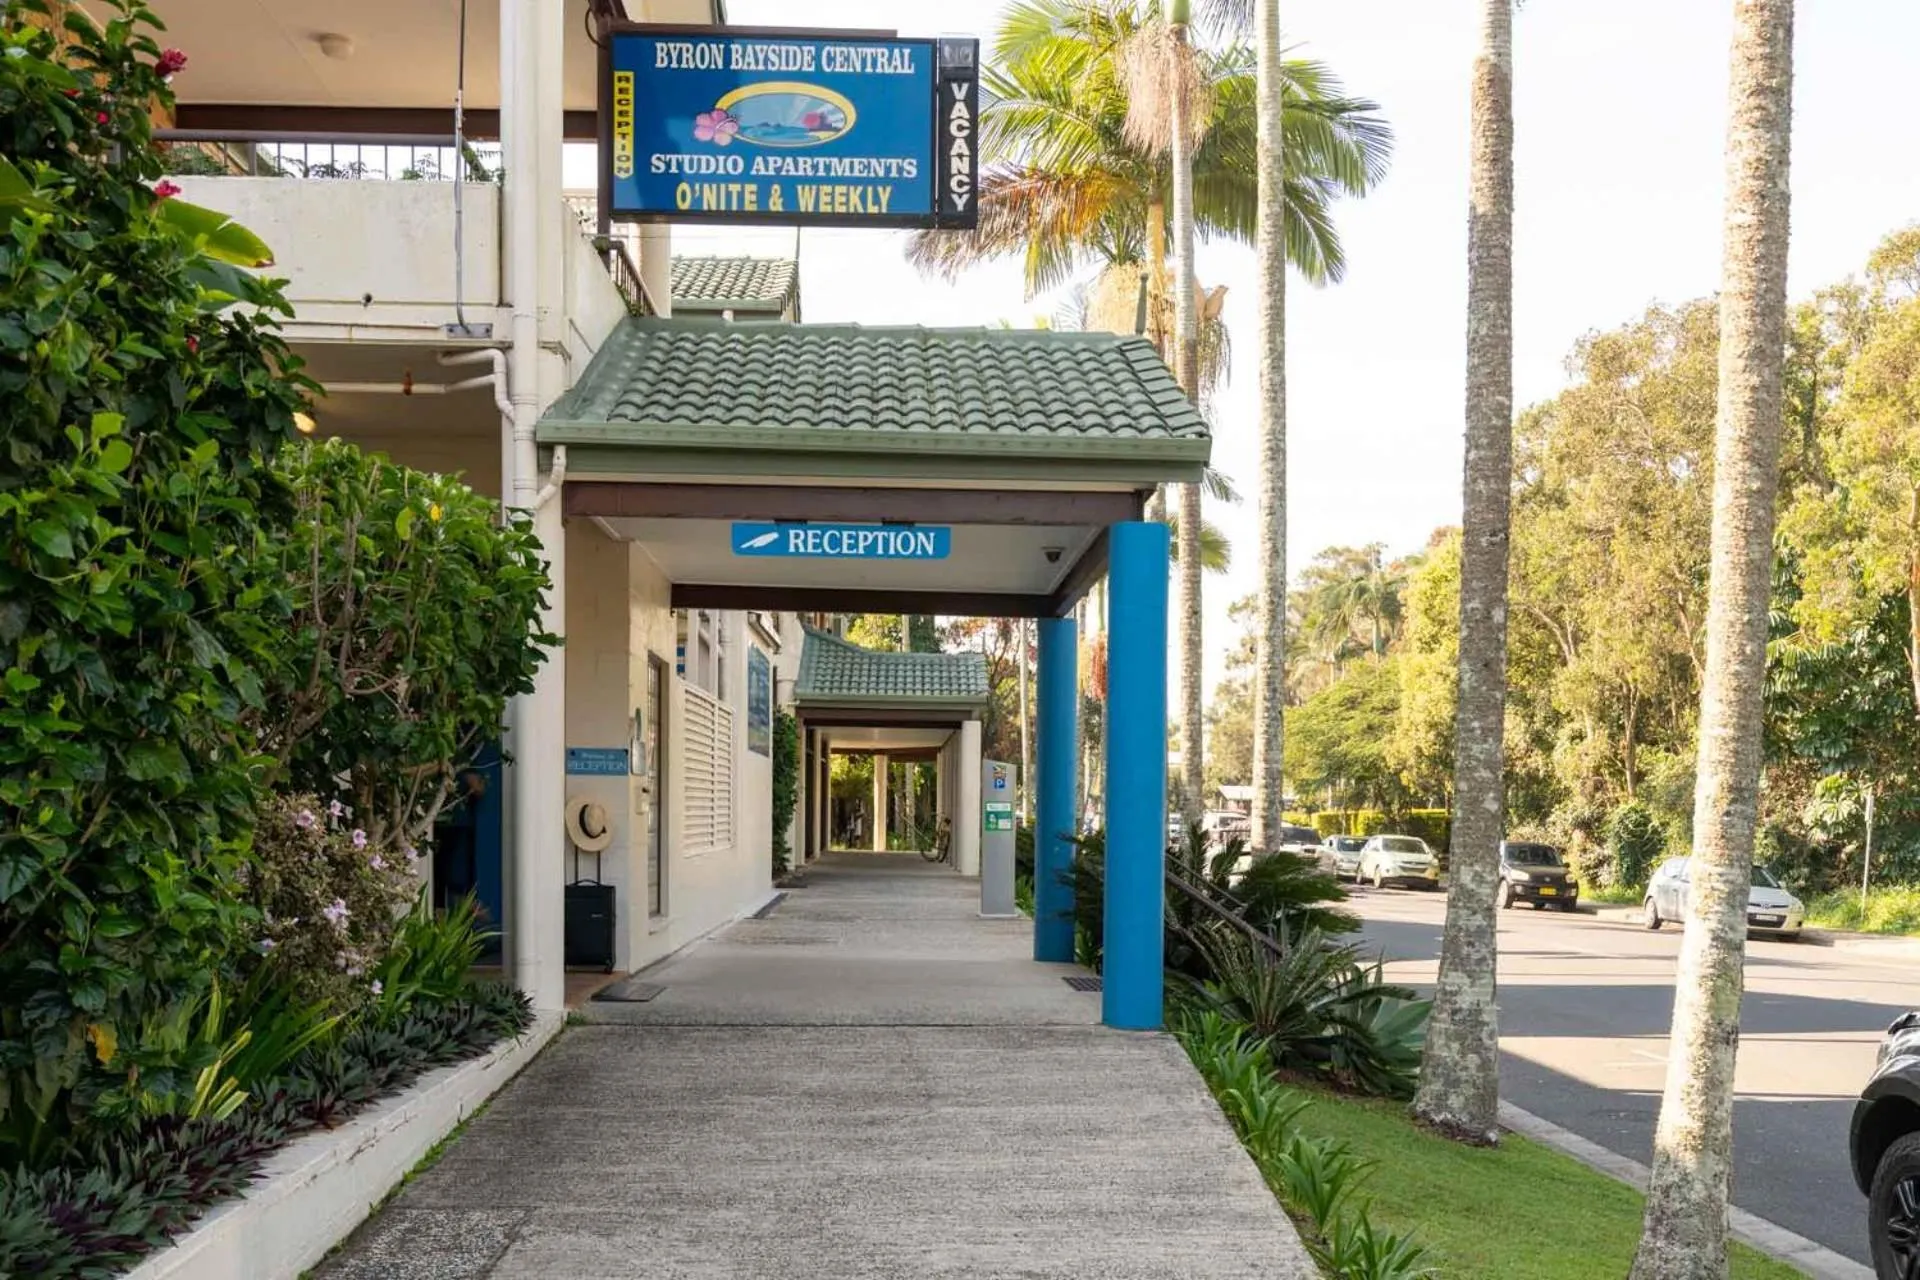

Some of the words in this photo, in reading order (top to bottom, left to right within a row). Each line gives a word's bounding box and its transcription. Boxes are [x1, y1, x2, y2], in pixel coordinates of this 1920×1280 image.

[655, 42, 725, 70] BYRON
[730, 45, 815, 72] BAYSIDE
[821, 46, 914, 74] CENTRAL
[616, 75, 631, 174] RECEPTION
[949, 83, 971, 212] VACANCY
[650, 153, 744, 175] STUDIO
[750, 156, 918, 178] APARTMENTS
[676, 182, 758, 210] O'NITE
[769, 184, 784, 212] &
[797, 184, 892, 213] WEEKLY
[788, 529, 935, 555] RECEPTION
